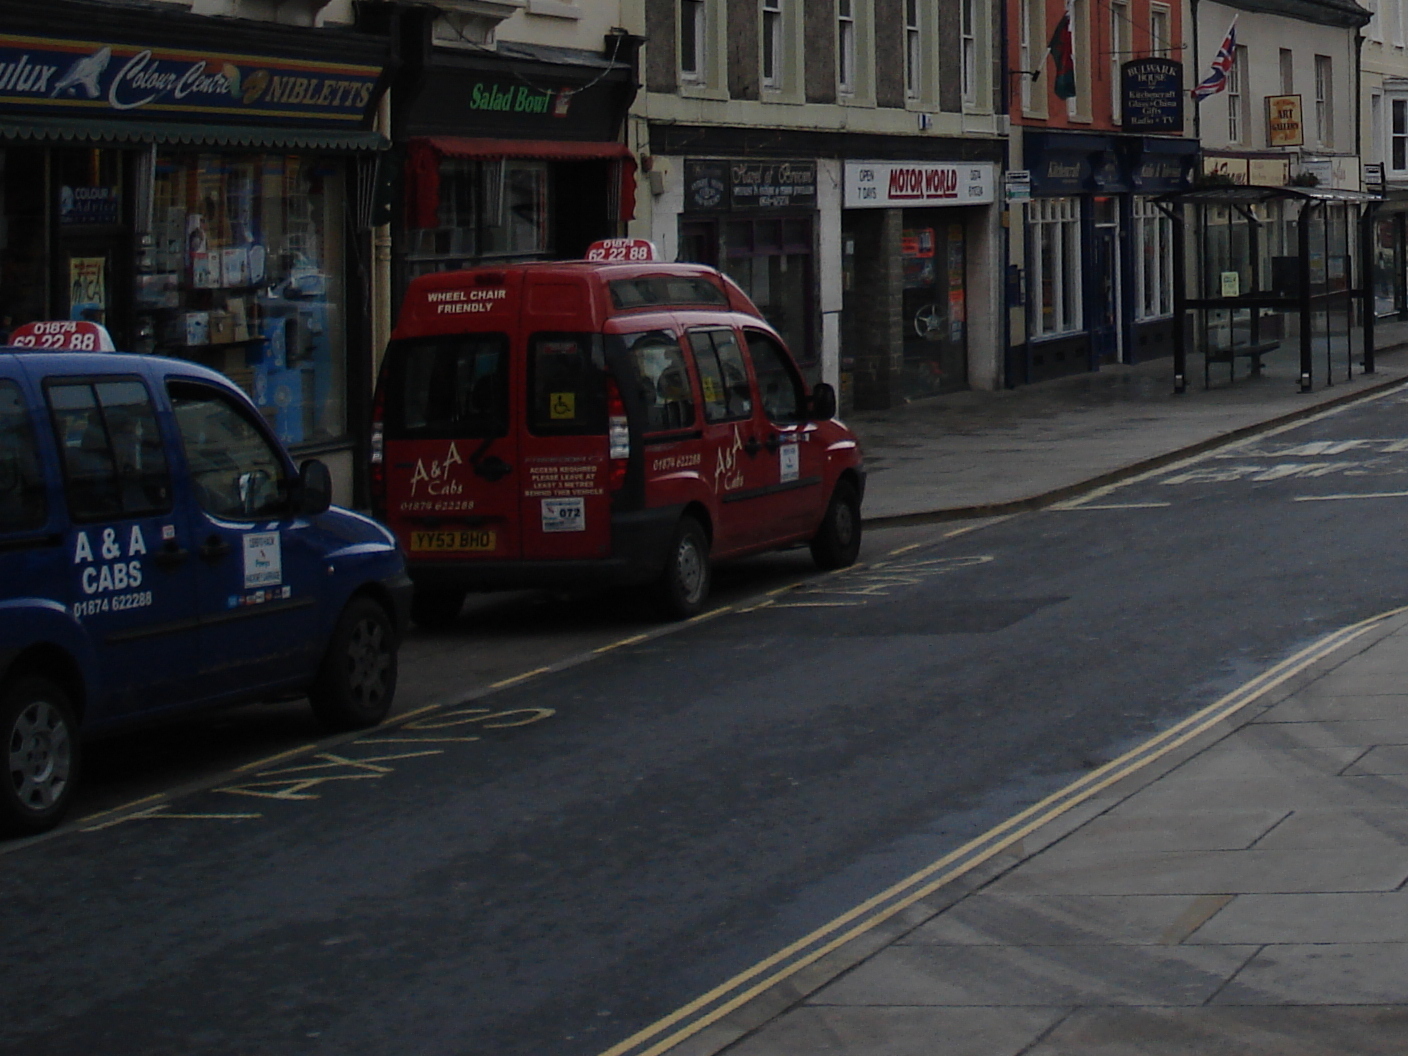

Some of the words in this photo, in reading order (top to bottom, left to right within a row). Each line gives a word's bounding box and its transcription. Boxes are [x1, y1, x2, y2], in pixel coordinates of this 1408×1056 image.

[1126, 64, 1178, 77] BULWARK
[109, 49, 177, 111] Colour
[174, 60, 232, 101] Centre
[264, 76, 375, 108] NIBLETTS
[1137, 74, 1166, 83] HOUSE
[469, 82, 515, 112] Salad
[514, 85, 551, 114] Bowl
[1142, 107, 1162, 118] Gifts
[1278, 109, 1294, 119] ART
[1162, 116, 1176, 124] TV
[859, 169, 875, 183] OPEN
[888, 168, 924, 200] MOTOR
[925, 168, 958, 199] WORLD
[862, 187, 877, 200] DAYS
[588, 249, 606, 262] 62
[608, 248, 626, 261] 22
[629, 246, 648, 261] 88
[427, 291, 467, 303] WHEEL
[469, 289, 507, 301] CHAIR
[437, 302, 494, 314] FRIENDLY
[33, 322, 77, 335] 01874
[652, 457, 676, 471] 01874
[714, 446, 726, 494] A
[732, 424, 744, 471] A
[410, 457, 430, 497] A
[430, 460, 442, 479] &
[443, 440, 463, 481] A
[560, 473, 584, 481] LEAVE
[427, 479, 464, 496] Cabs
[559, 508, 580, 518] 072
[74, 531, 95, 564] A
[101, 527, 121, 561] &
[128, 524, 148, 558] A
[416, 532, 455, 548] YY53
[459, 532, 490, 547] BHO
[82, 560, 143, 595] CABS
[73, 598, 109, 618] 01874
[111, 590, 153, 611] 622288
[79, 707, 557, 833] TAXIS
